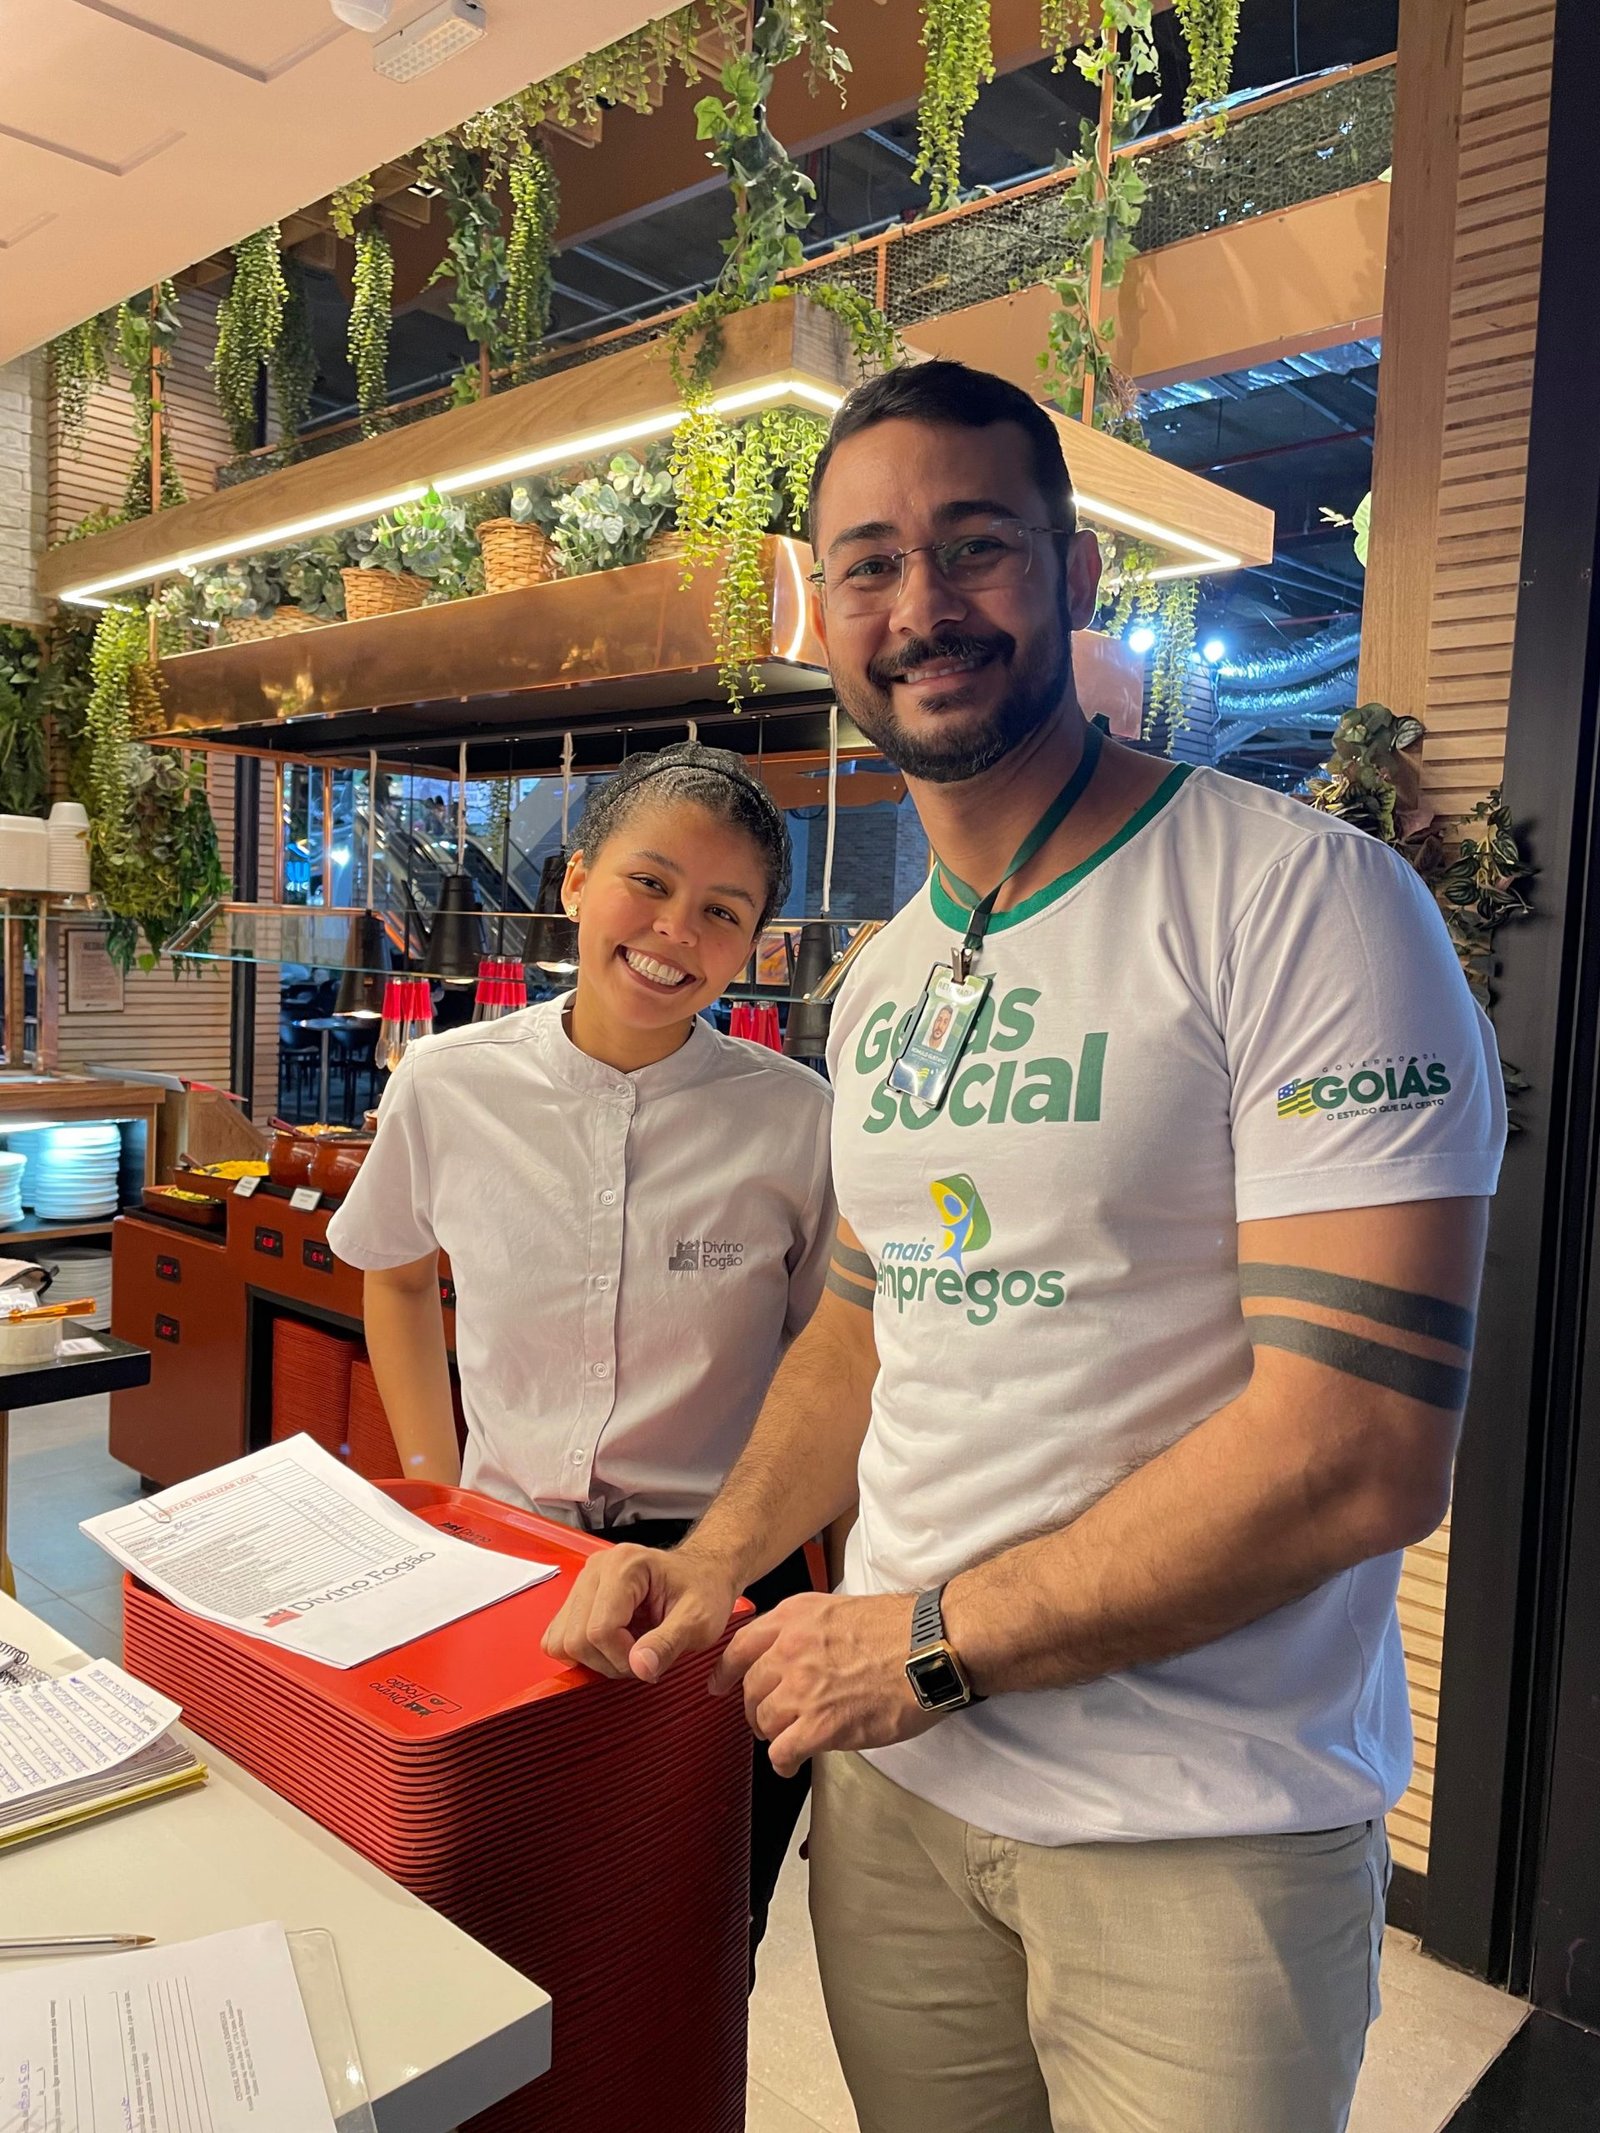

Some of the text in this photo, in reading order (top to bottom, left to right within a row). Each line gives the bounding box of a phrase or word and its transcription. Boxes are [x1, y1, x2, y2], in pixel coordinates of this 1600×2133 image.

[854, 972, 1042, 1075] Gás
[1322, 1055, 1405, 1073] GOVERNO
[1311, 1056, 1452, 1110] GOIÁS
[1326, 1113, 1335, 1121] O
[1337, 1106, 1378, 1120] ESTADO
[1379, 1104, 1399, 1113] QUE
[1415, 1098, 1445, 1110] CERTO
[702, 1240, 744, 1254] Divino
[881, 1237, 935, 1262] mais
[702, 1254, 743, 1270] Fogão
[288, 1580, 369, 1611] Divino
[366, 1551, 437, 1581] Fogão
[369, 1682, 409, 1705] Divino
